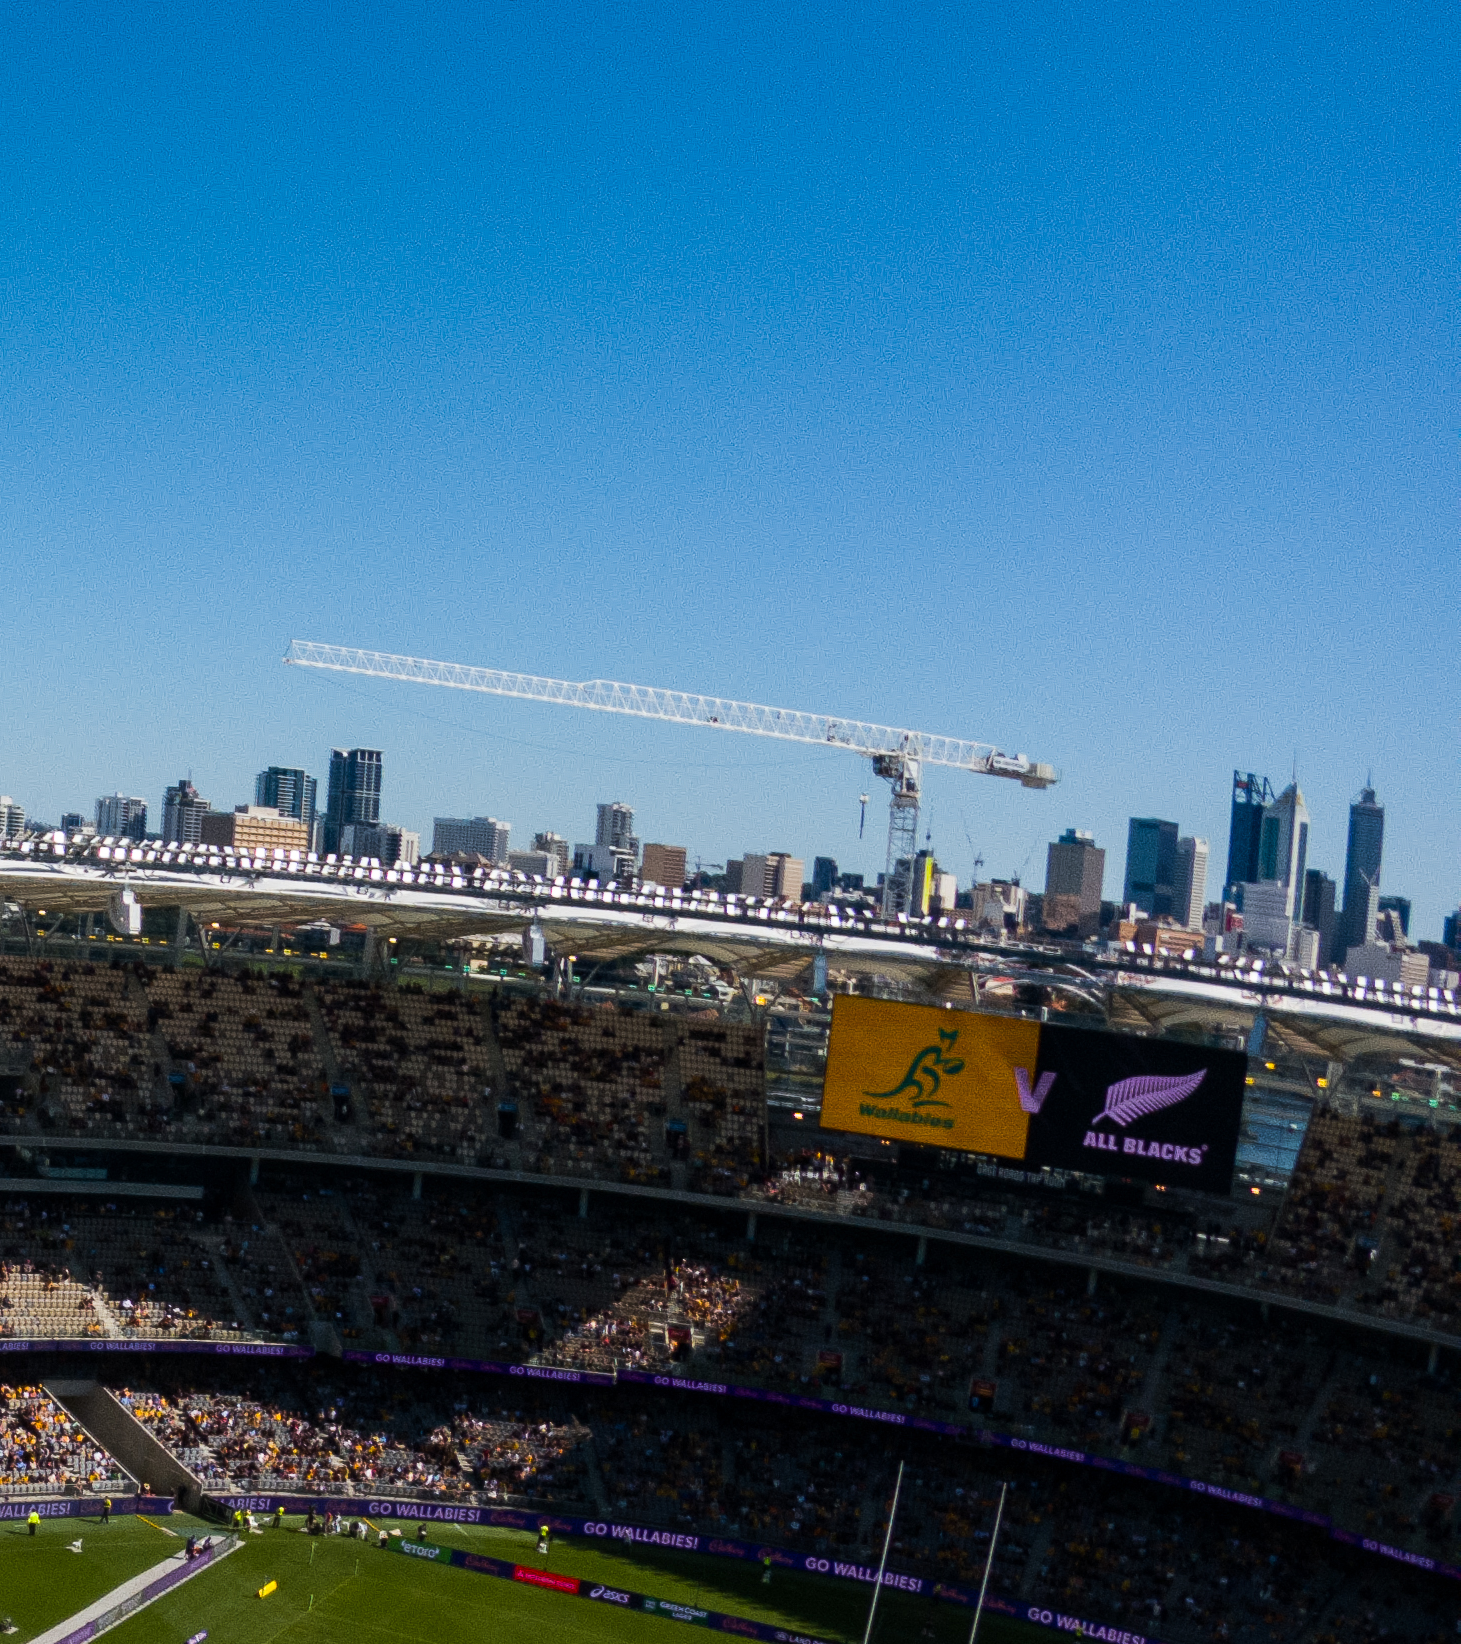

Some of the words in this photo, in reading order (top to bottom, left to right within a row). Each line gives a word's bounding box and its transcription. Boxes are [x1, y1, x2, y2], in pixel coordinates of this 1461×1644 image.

[1013, 1066, 1058, 1115] V
[859, 1102, 955, 1129] Wallabies
[1082, 1130, 1119, 1153] ALL
[509, 1365, 525, 1377] GO
[654, 1375, 670, 1386] GO
[831, 1403, 847, 1414] GO
[1010, 1437, 1027, 1449] GO
[369, 1502, 392, 1515] GO
[396, 1503, 481, 1522] WALLABIES!
[583, 1521, 607, 1536] GO
[611, 1524, 699, 1550] WALLABIES!
[804, 1556, 829, 1573] GO
[833, 1561, 923, 1593] WALLABIES!
[1027, 1606, 1053, 1625] GO
